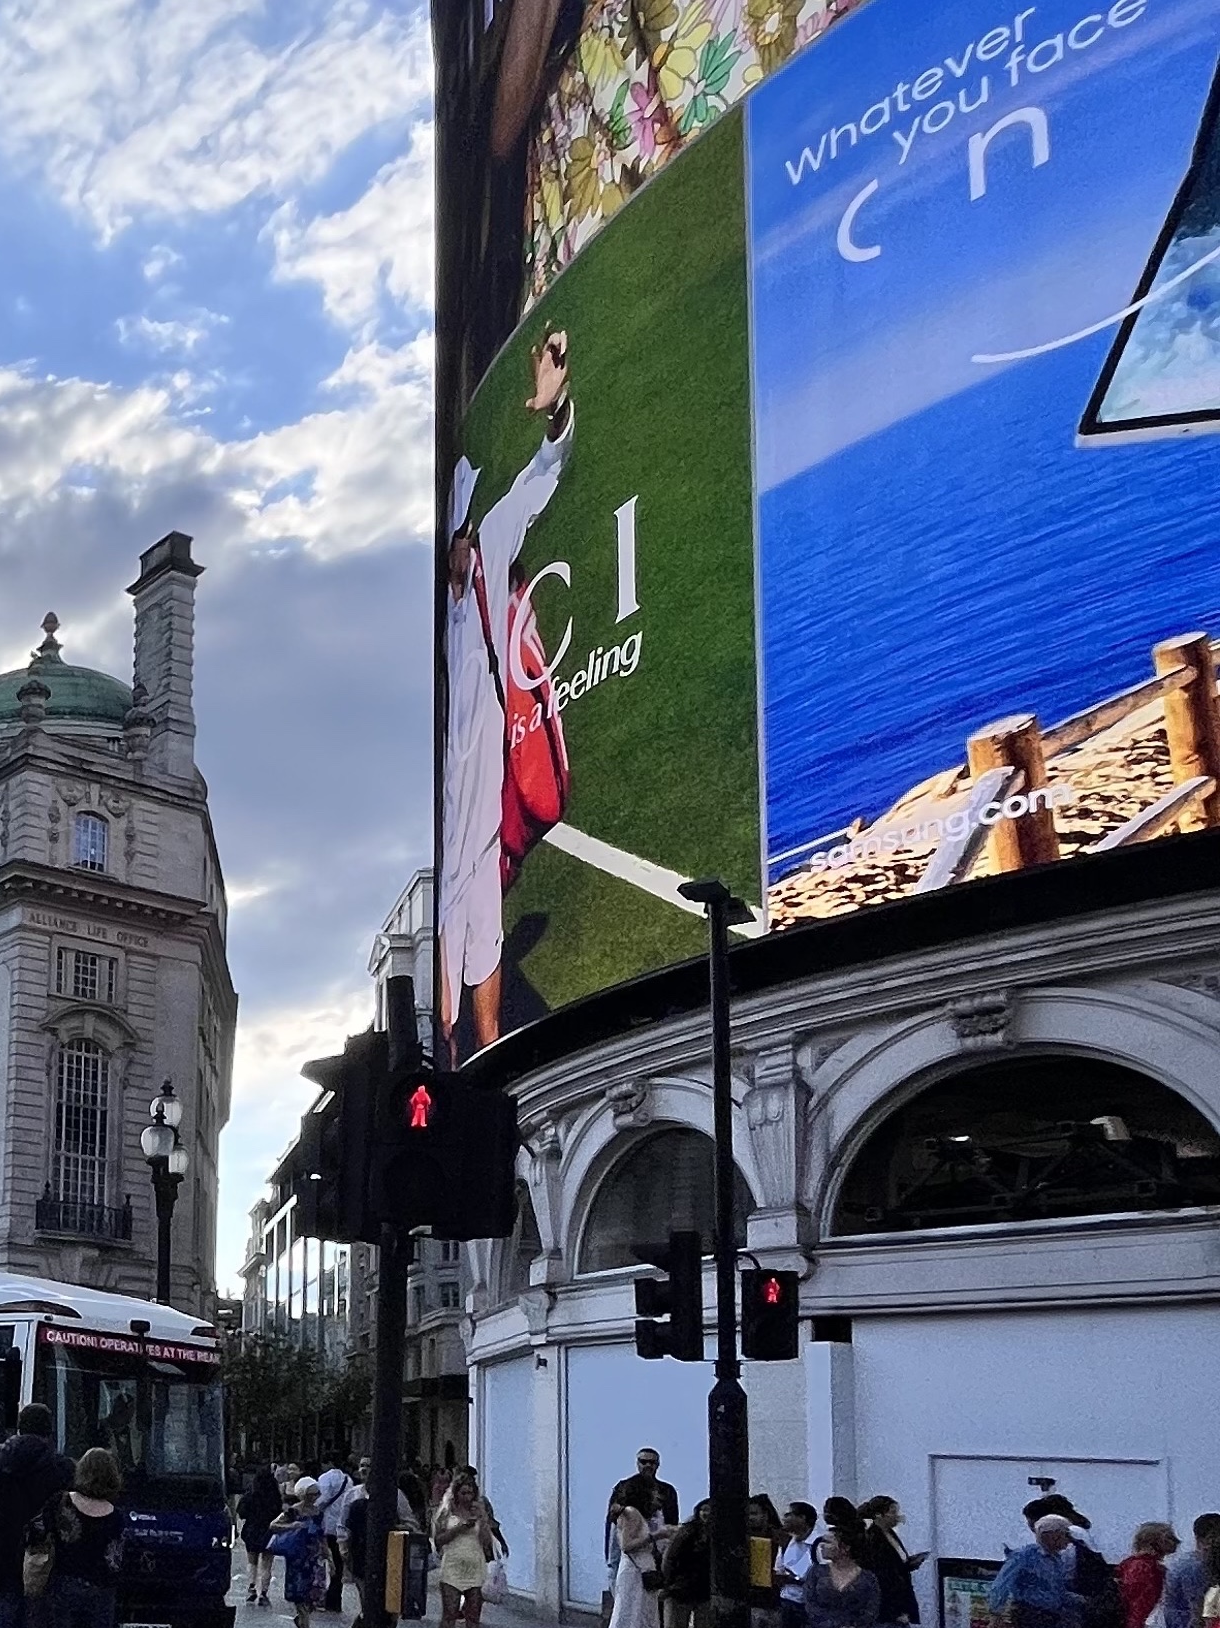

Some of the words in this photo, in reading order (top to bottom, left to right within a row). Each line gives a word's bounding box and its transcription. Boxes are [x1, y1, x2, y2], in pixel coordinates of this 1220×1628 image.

[784, 7, 1036, 186] whatever
[891, 75, 989, 165] you
[1003, 0, 1148, 87] face
[510, 712, 527, 750] is
[528, 702, 543, 733] a
[546, 630, 643, 720] feeling
[809, 783, 1072, 873] samsung.com
[86, 923, 108, 940] LIFE
[163, 1346, 175, 1359] AT
[177, 1349, 196, 1362] THE
